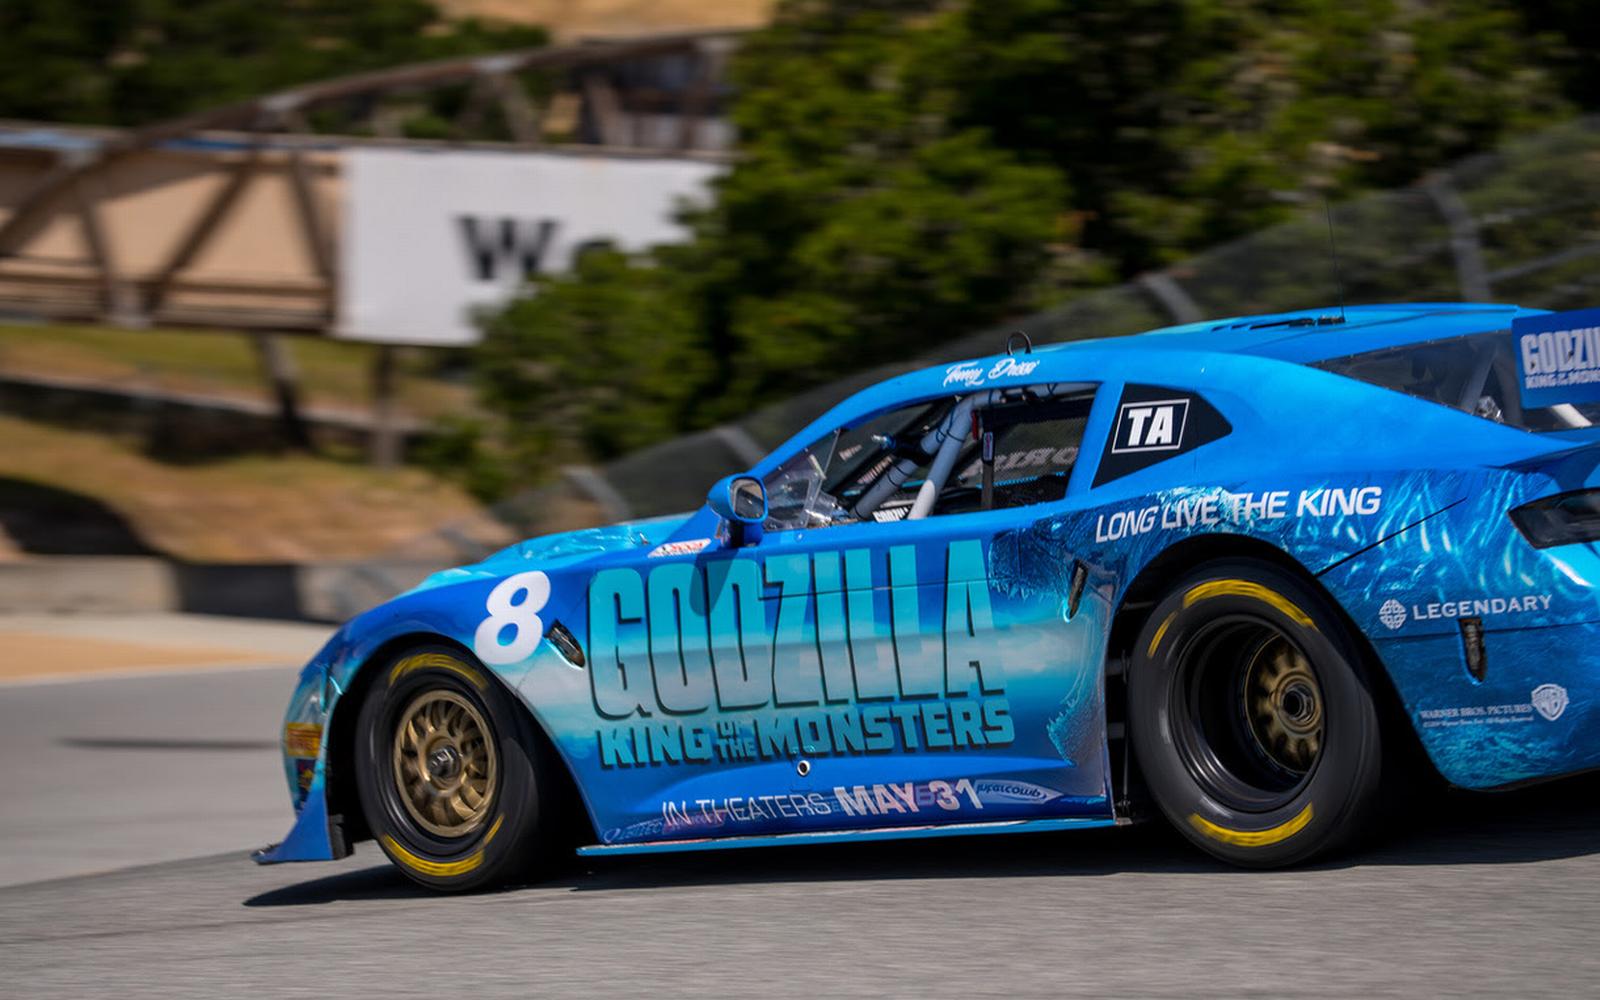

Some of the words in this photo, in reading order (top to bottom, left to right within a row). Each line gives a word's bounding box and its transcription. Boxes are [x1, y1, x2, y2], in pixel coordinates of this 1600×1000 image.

[1127, 406, 1175, 447] TA
[1095, 505, 1159, 543] LONG
[1161, 494, 1221, 530] LIVE
[1226, 490, 1290, 525] THE
[1296, 486, 1382, 517] KING
[474, 570, 551, 664] 8
[588, 539, 1006, 720] GODZILLA
[1412, 594, 1552, 620] LEGENDARY
[597, 720, 716, 768] KING
[716, 737, 758, 765] THE
[717, 720, 743, 738] OF
[754, 698, 1015, 761] MONSTERS
[660, 799, 693, 826] IN
[695, 792, 832, 824] THEATERS
[832, 781, 921, 817] MAY
[928, 778, 984, 811] 31
